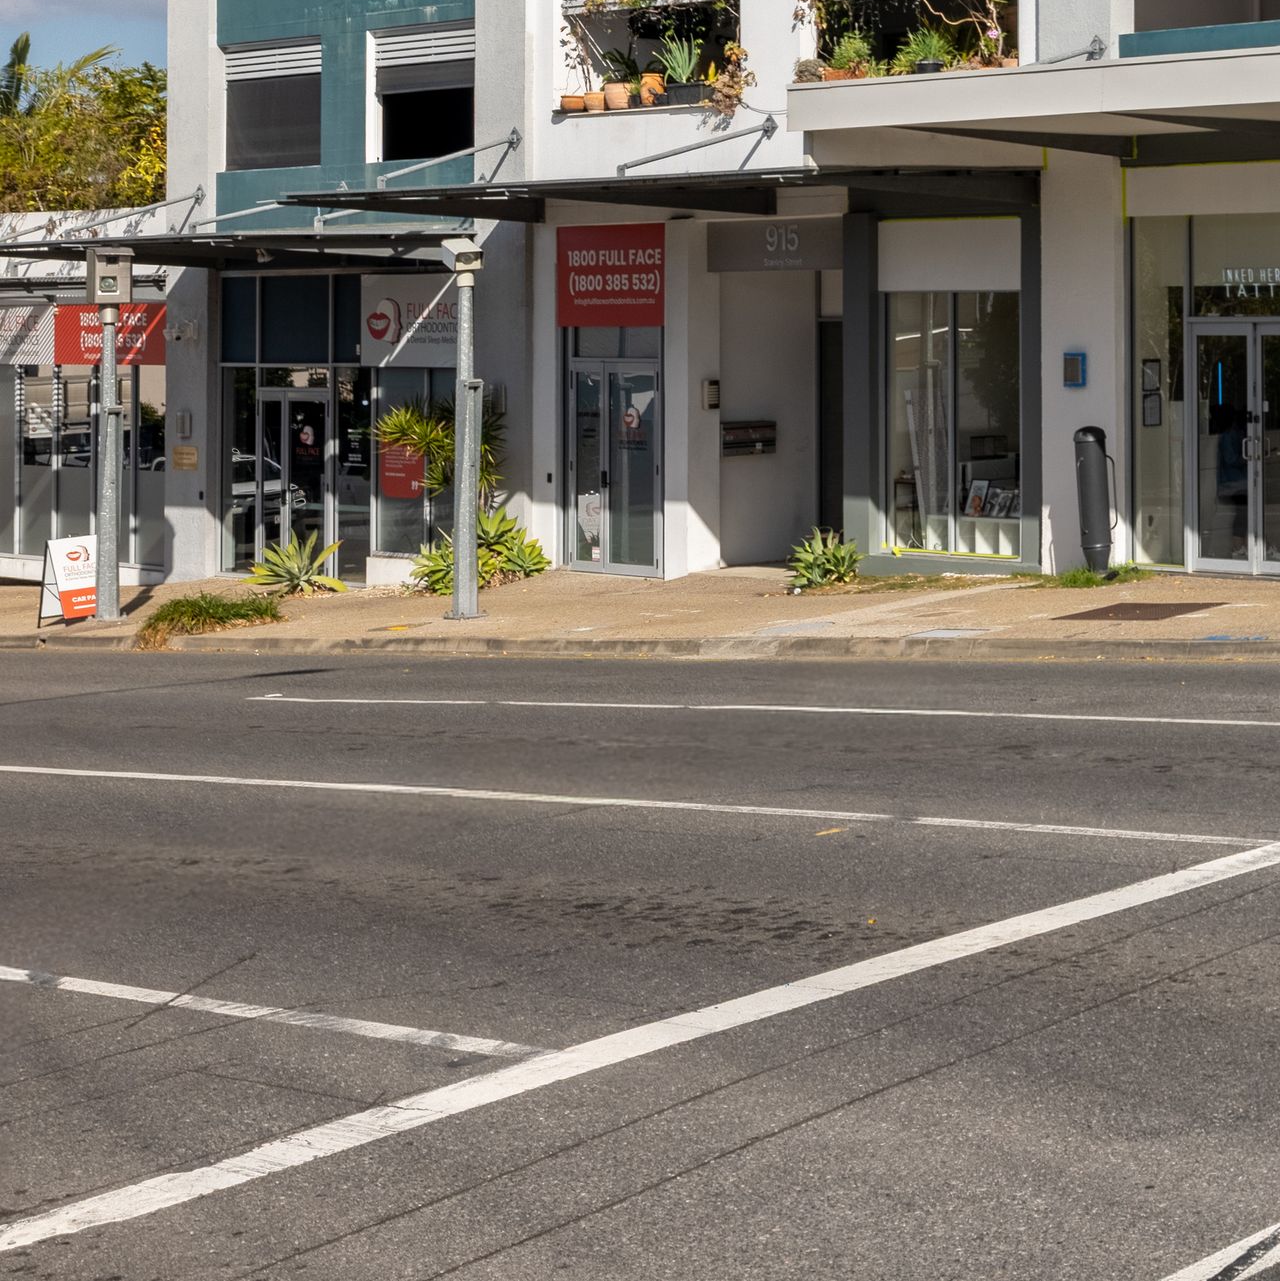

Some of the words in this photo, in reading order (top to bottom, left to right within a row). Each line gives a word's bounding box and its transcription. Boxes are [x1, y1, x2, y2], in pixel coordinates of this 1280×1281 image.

[766, 224, 799, 252] 915
[567, 249, 596, 267] 1800
[598, 249, 627, 266] FULL
[628, 248, 662, 265] FACE
[569, 271, 603, 296] (1800
[605, 273, 629, 291] 385
[632, 269, 660, 294] 532)
[1222, 268, 1254, 283] INKED
[122, 312, 148, 327] FACE
[406, 303, 434, 320] FULL
[63, 564, 81, 573] FULL
